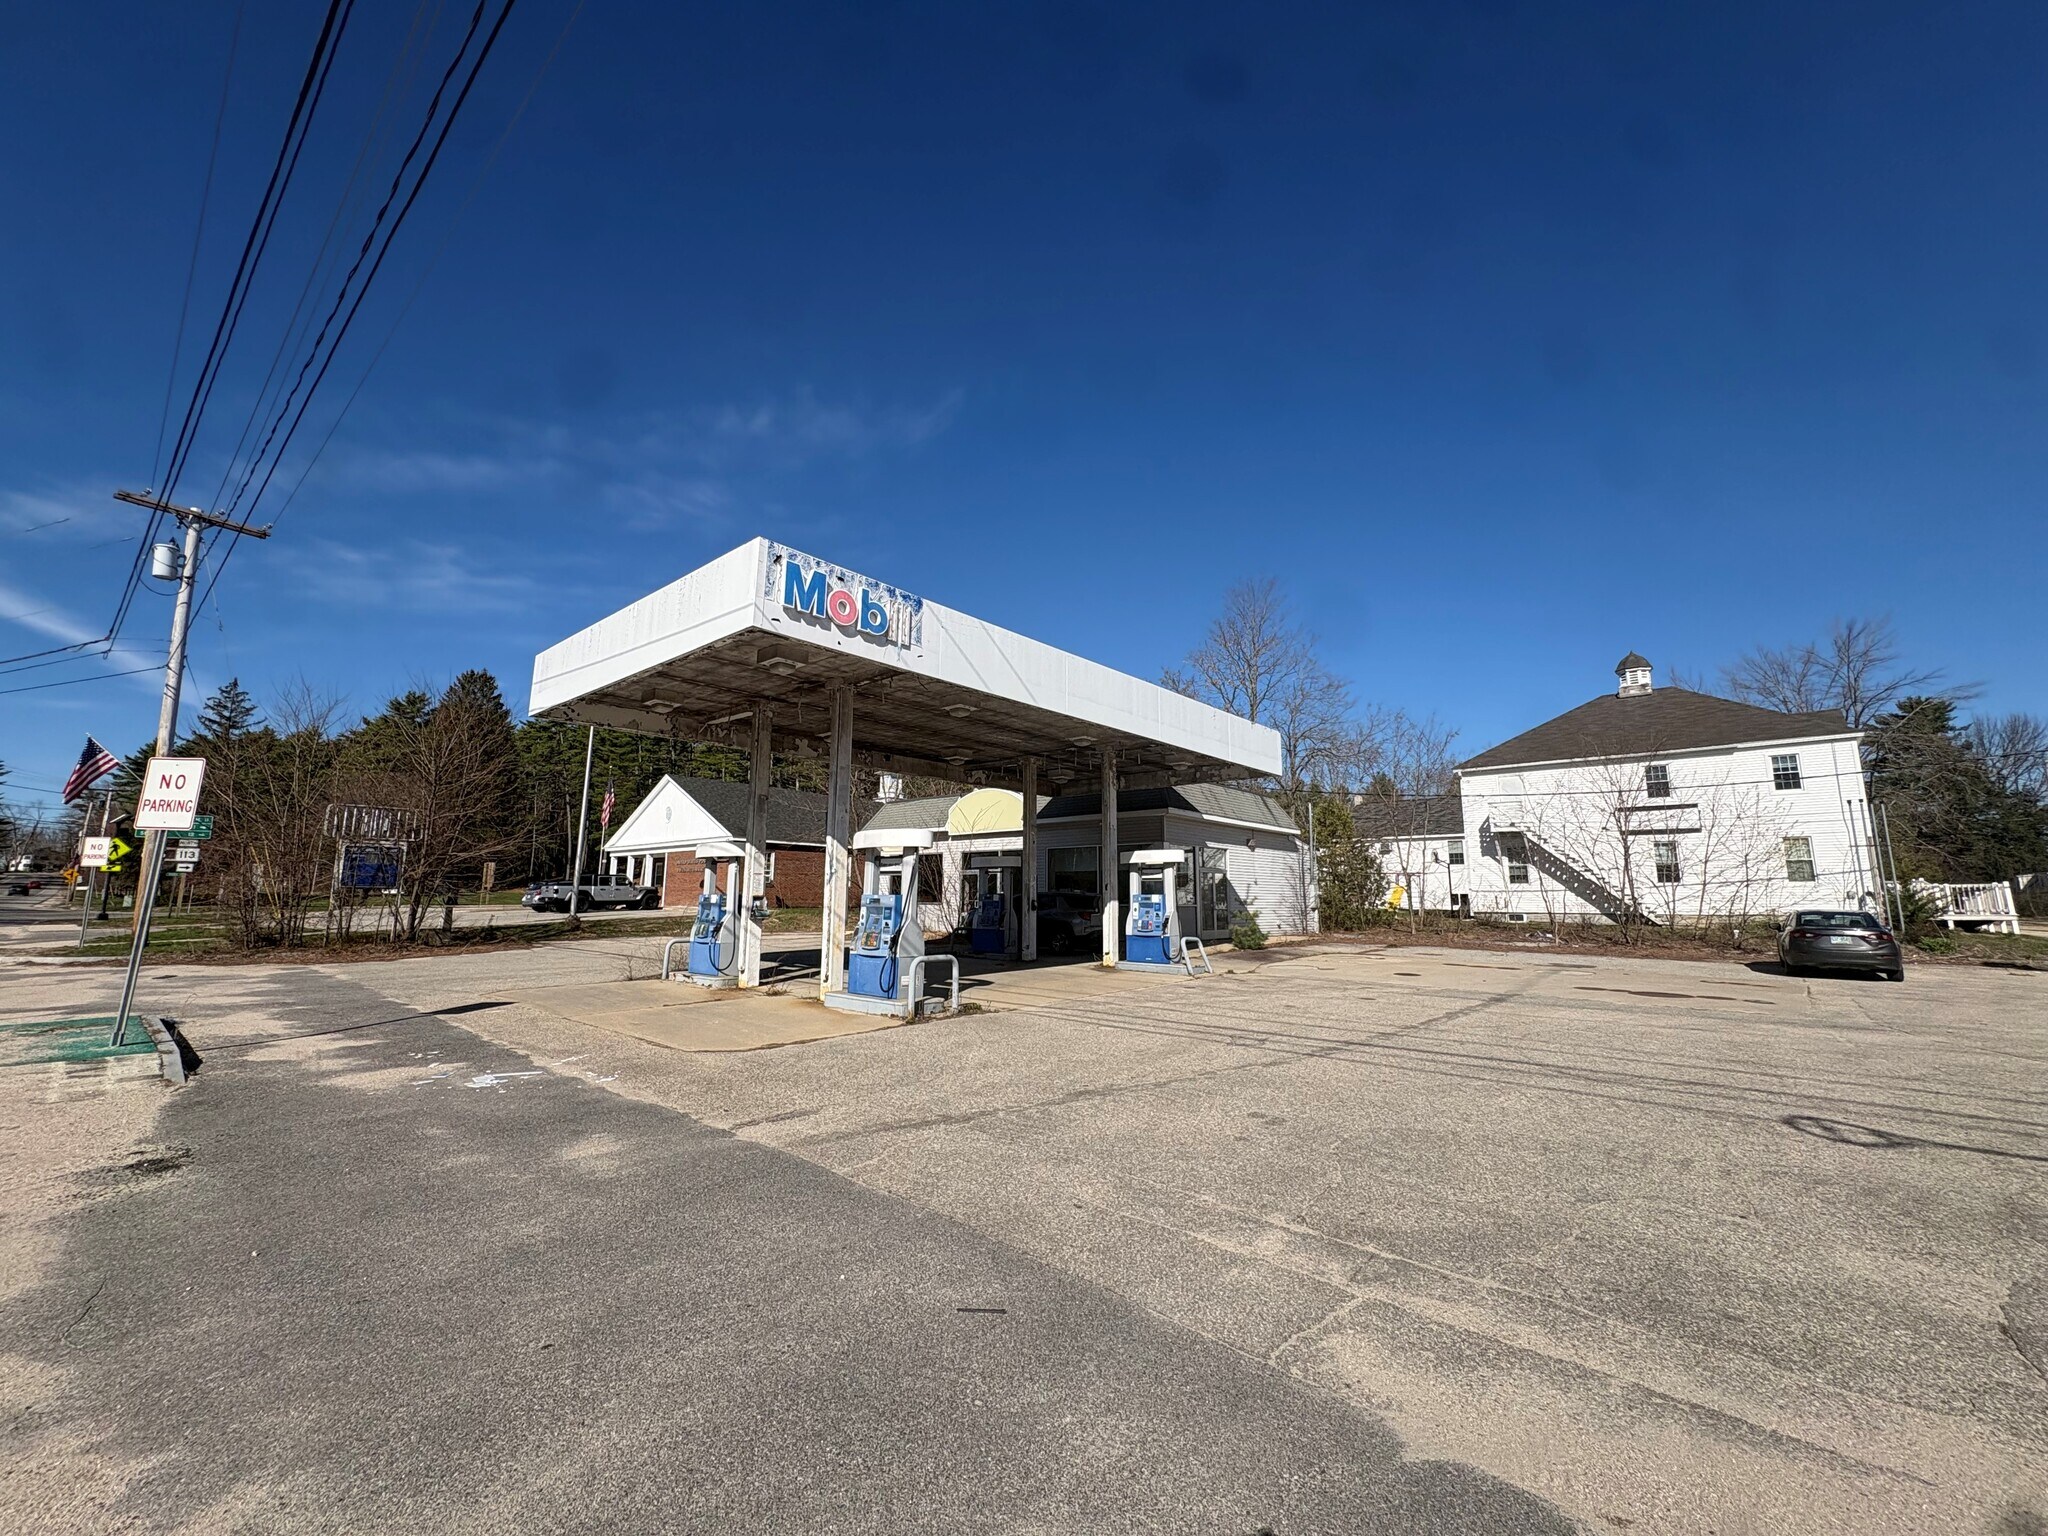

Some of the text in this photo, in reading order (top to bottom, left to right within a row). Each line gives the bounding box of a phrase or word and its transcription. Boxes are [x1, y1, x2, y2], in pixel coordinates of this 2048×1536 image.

[159, 774, 187, 790] NO
[142, 799, 194, 813] PARKING
[90, 843, 104, 851] NO
[179, 851, 196, 859] 113
